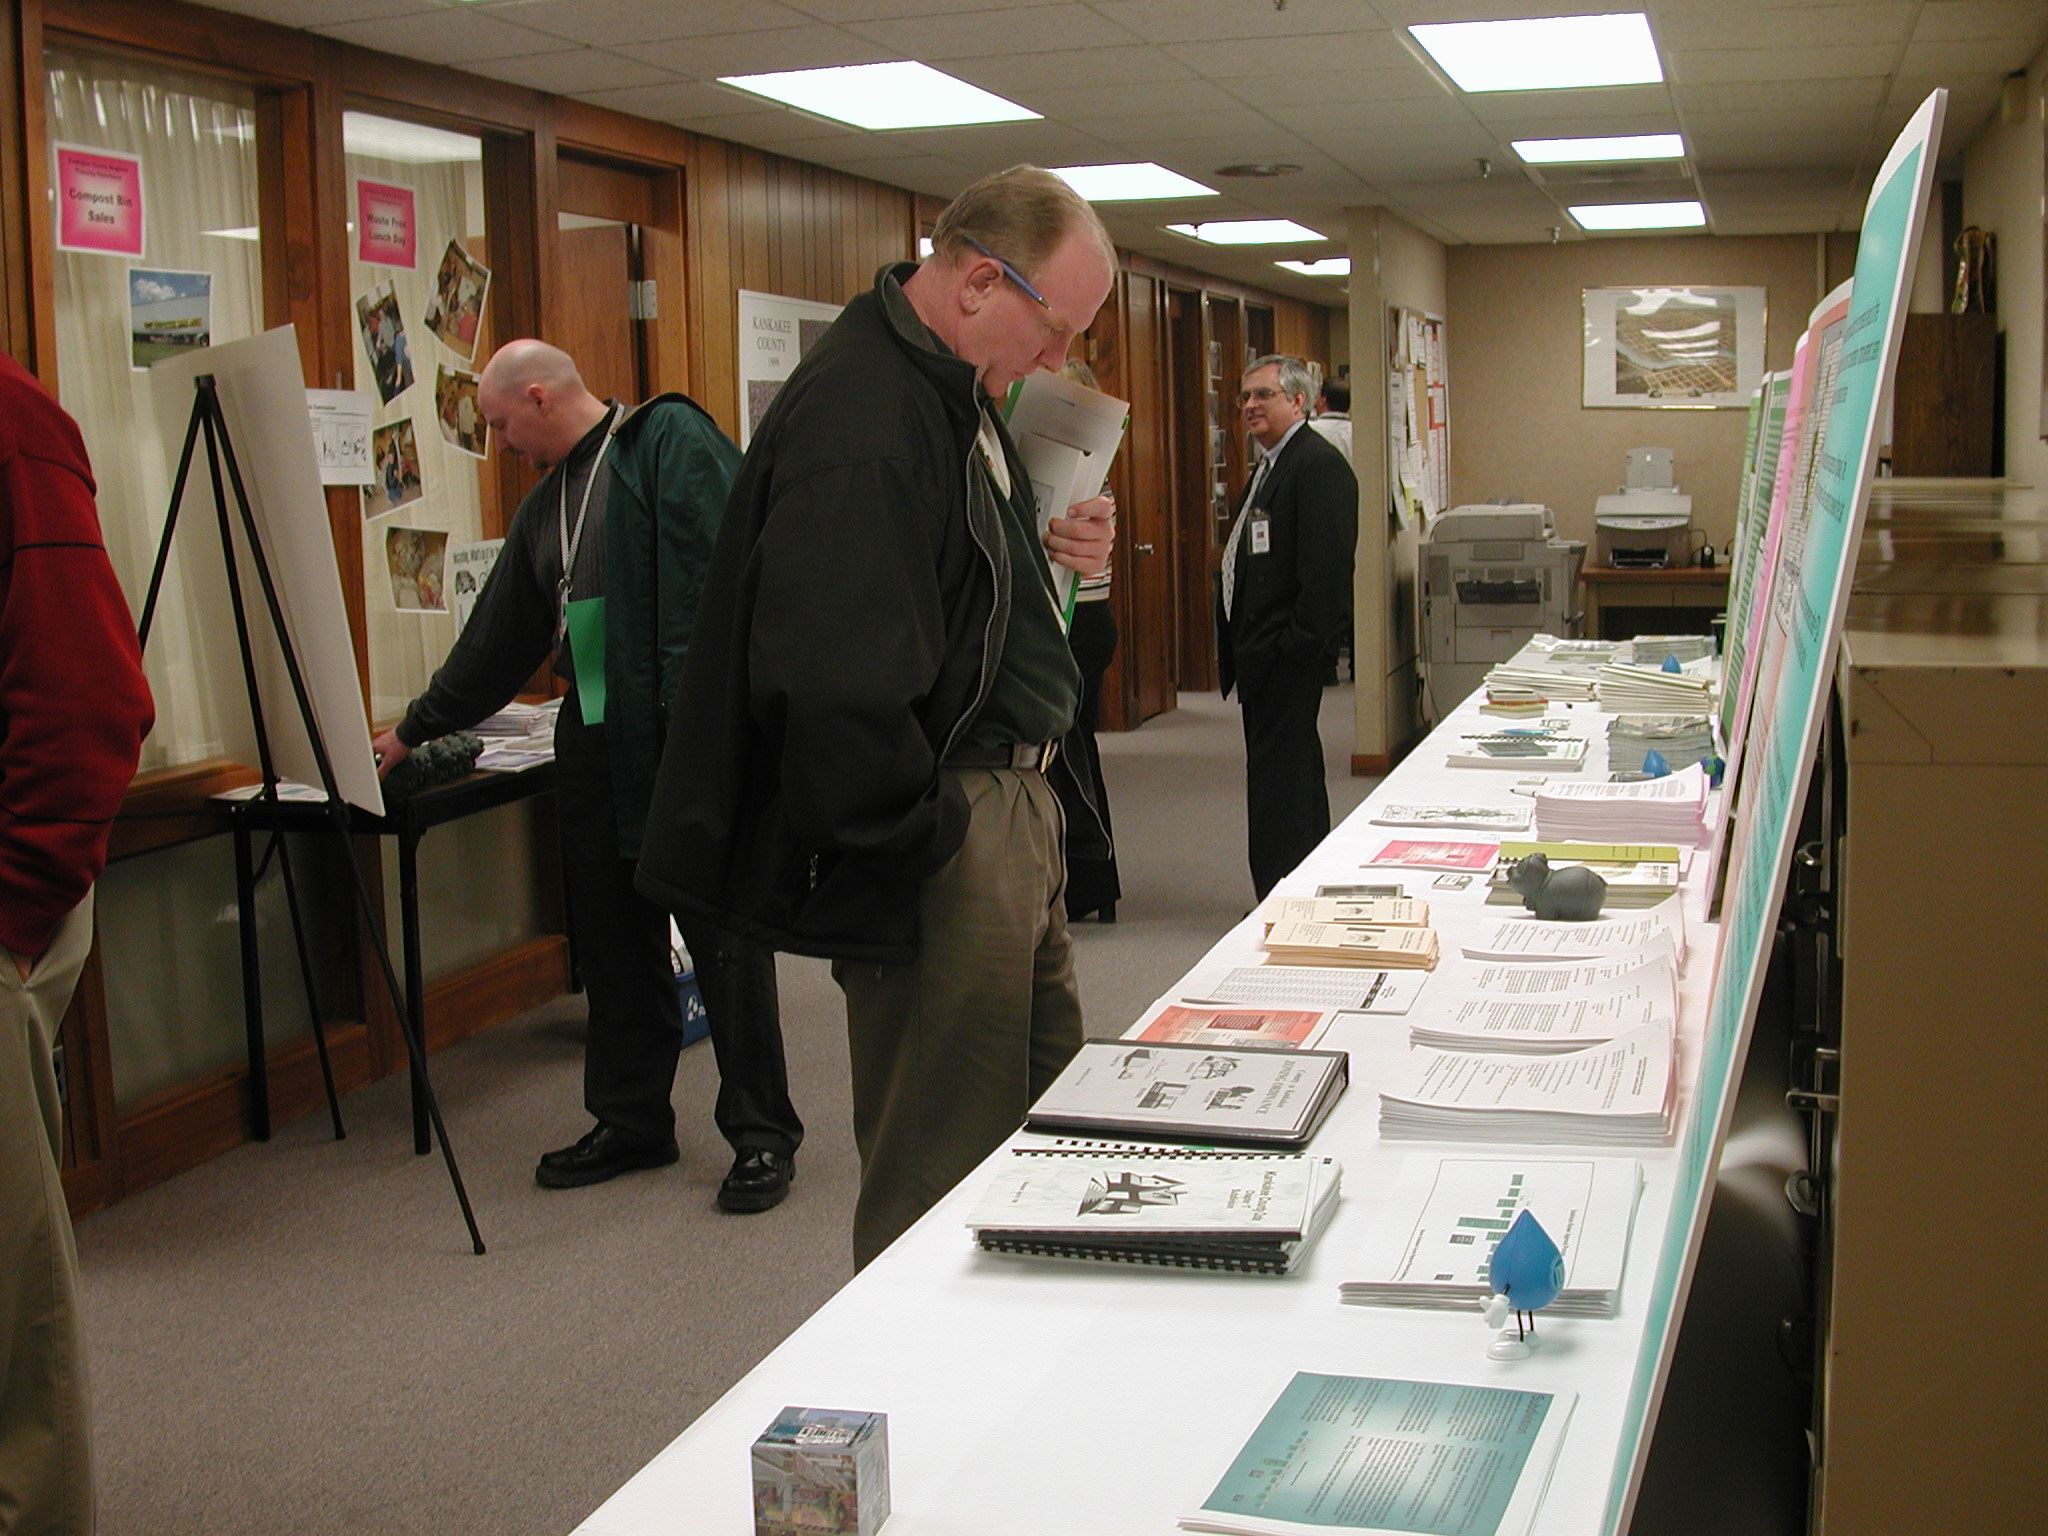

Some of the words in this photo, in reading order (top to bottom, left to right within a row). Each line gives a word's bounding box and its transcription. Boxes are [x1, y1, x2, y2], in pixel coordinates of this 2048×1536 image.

[69, 187, 114, 205] Compost
[117, 195, 133, 207] Bin
[88, 209, 115, 225] Sales
[367, 213, 389, 226] Waste
[368, 229, 391, 242] Lunch
[393, 233, 406, 248] Day
[752, 316, 792, 334] KANKAKEE
[756, 336, 787, 352] COUNTY
[1275, 1060, 1296, 1082] ZONING
[1255, 1081, 1284, 1114] ORDINANCE
[1261, 1170, 1277, 1196] Kankakee
[1252, 1197, 1271, 1211] County
